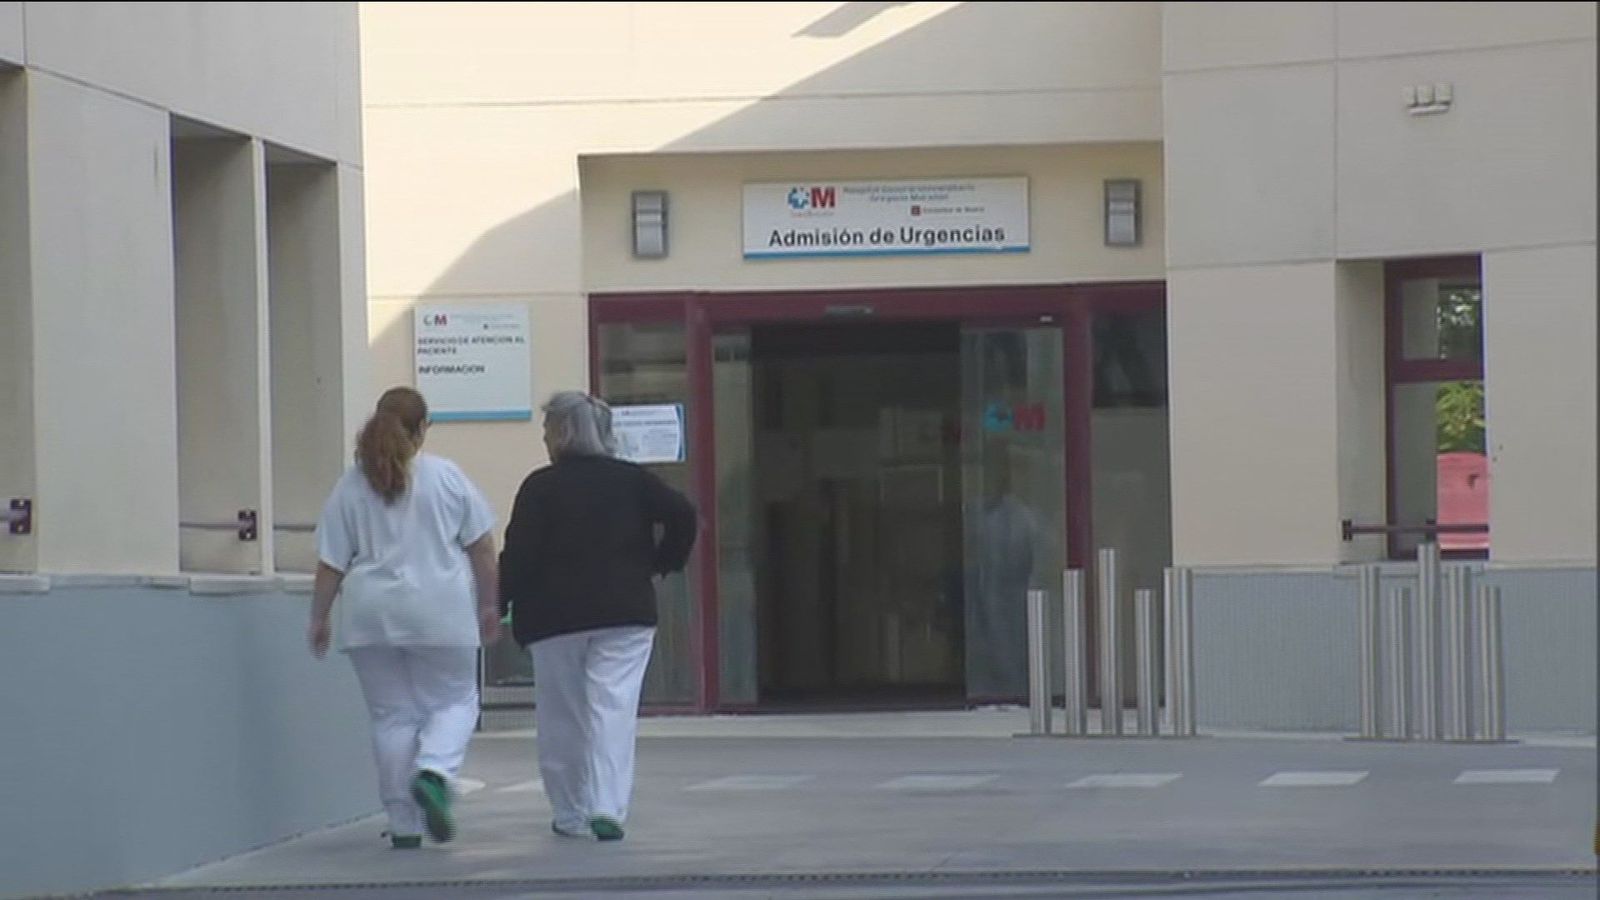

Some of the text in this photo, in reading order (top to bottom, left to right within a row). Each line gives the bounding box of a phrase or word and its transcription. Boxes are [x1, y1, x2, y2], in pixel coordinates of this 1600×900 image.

[768, 224, 1006, 247] Admisión de Urgencias
